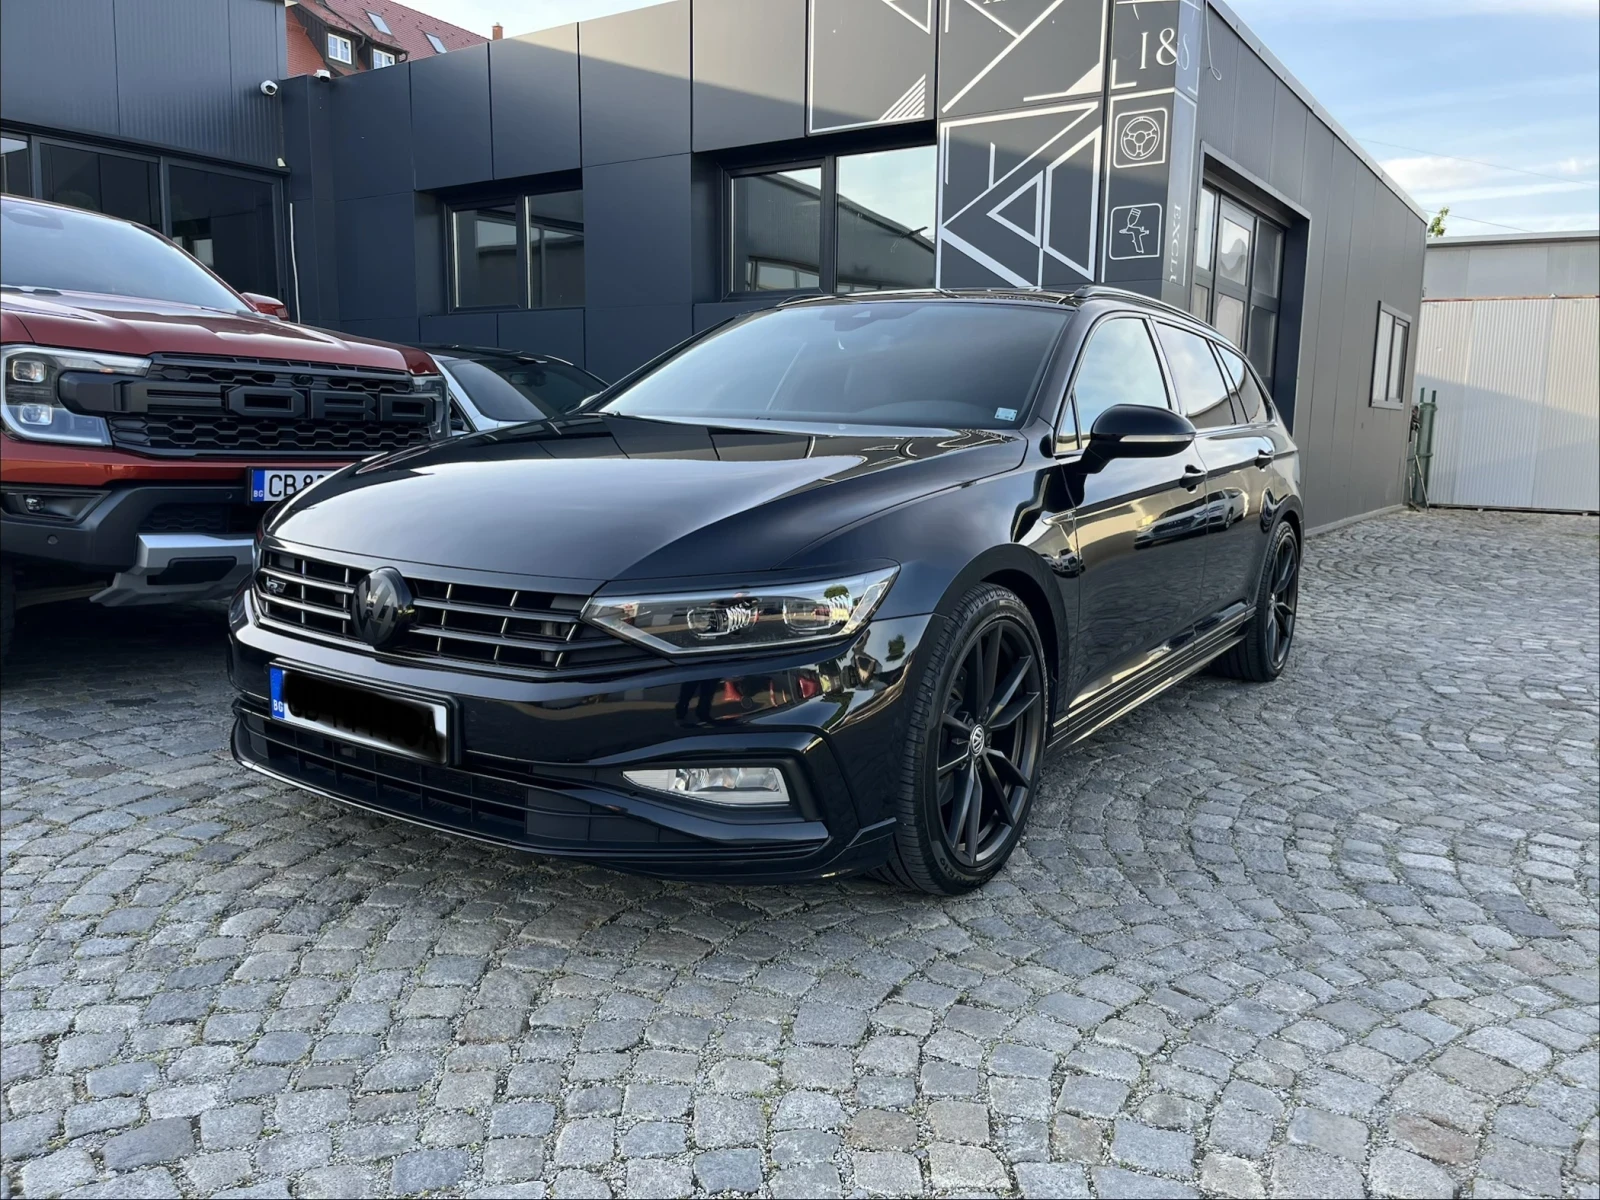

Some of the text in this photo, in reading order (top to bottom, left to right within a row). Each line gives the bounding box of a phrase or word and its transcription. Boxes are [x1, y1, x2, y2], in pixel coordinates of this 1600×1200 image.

[114, 380, 437, 422] FORD
[253, 489, 264, 498] BG
[269, 474, 297, 497] CB
[273, 699, 284, 713] BG
